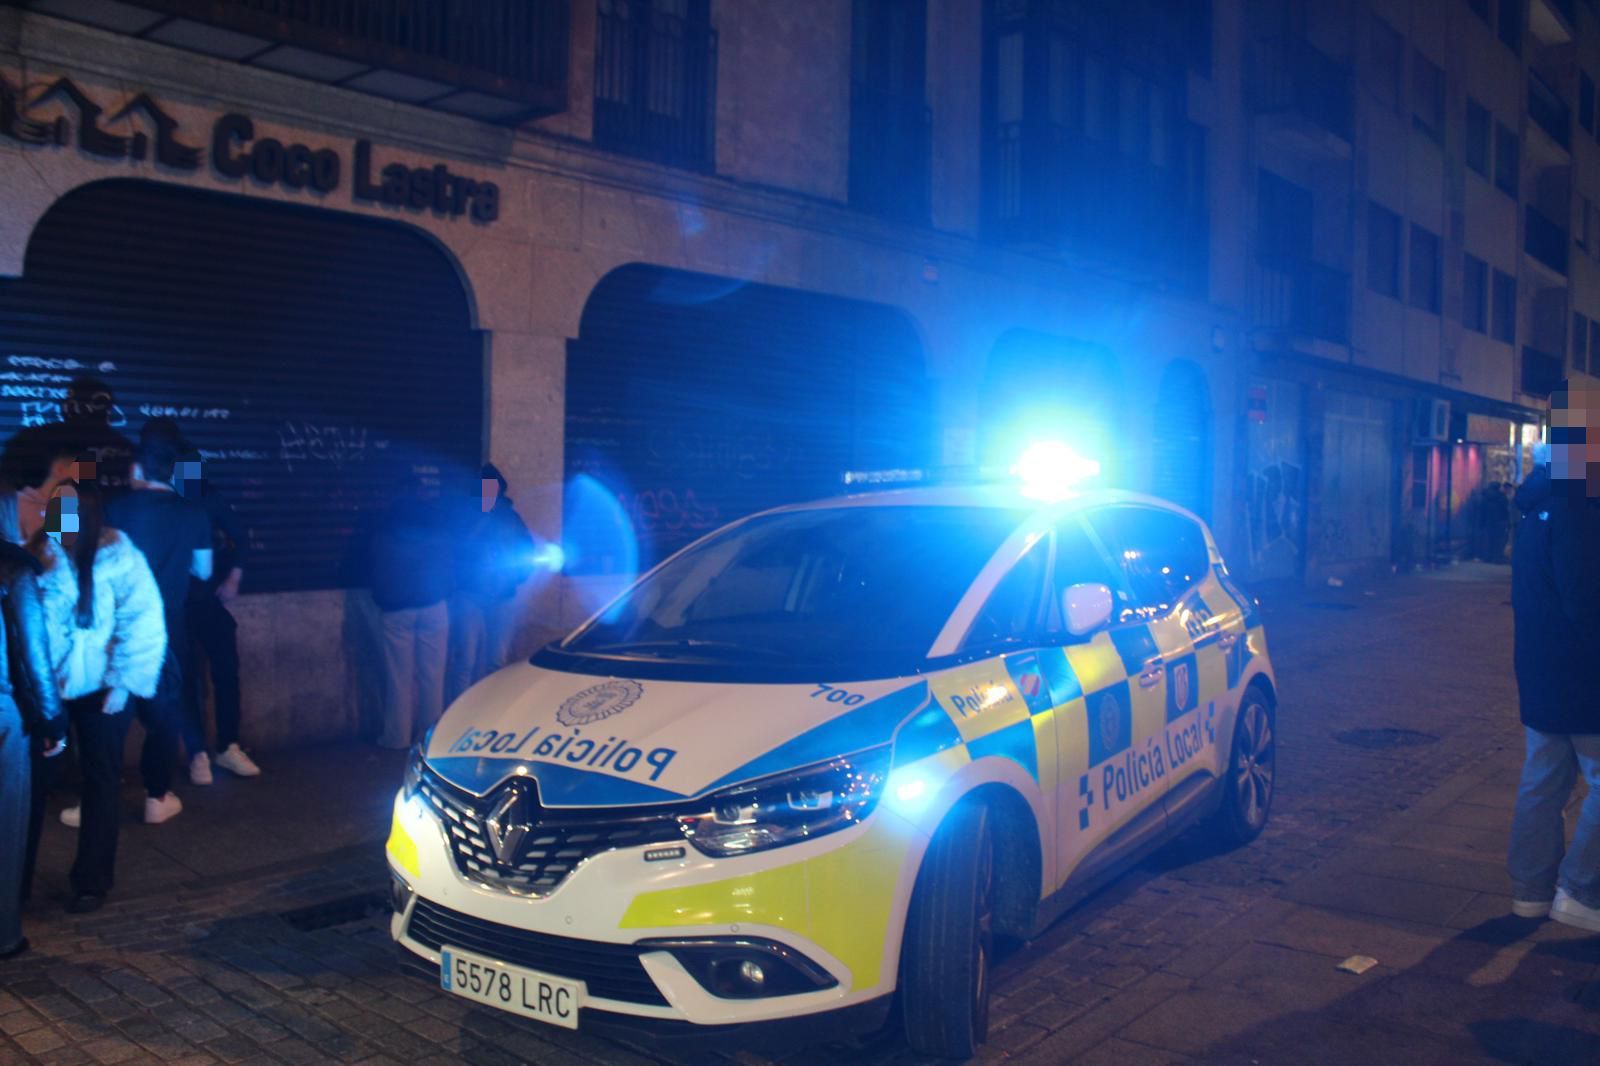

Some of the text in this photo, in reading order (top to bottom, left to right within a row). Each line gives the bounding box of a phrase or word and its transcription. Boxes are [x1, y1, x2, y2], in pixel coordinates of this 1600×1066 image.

[212, 112, 501, 224] Coco Lastra
[809, 682, 865, 706] 700
[1103, 718, 1204, 811] Policía Local
[455, 957, 572, 1019] 5578 LRC
